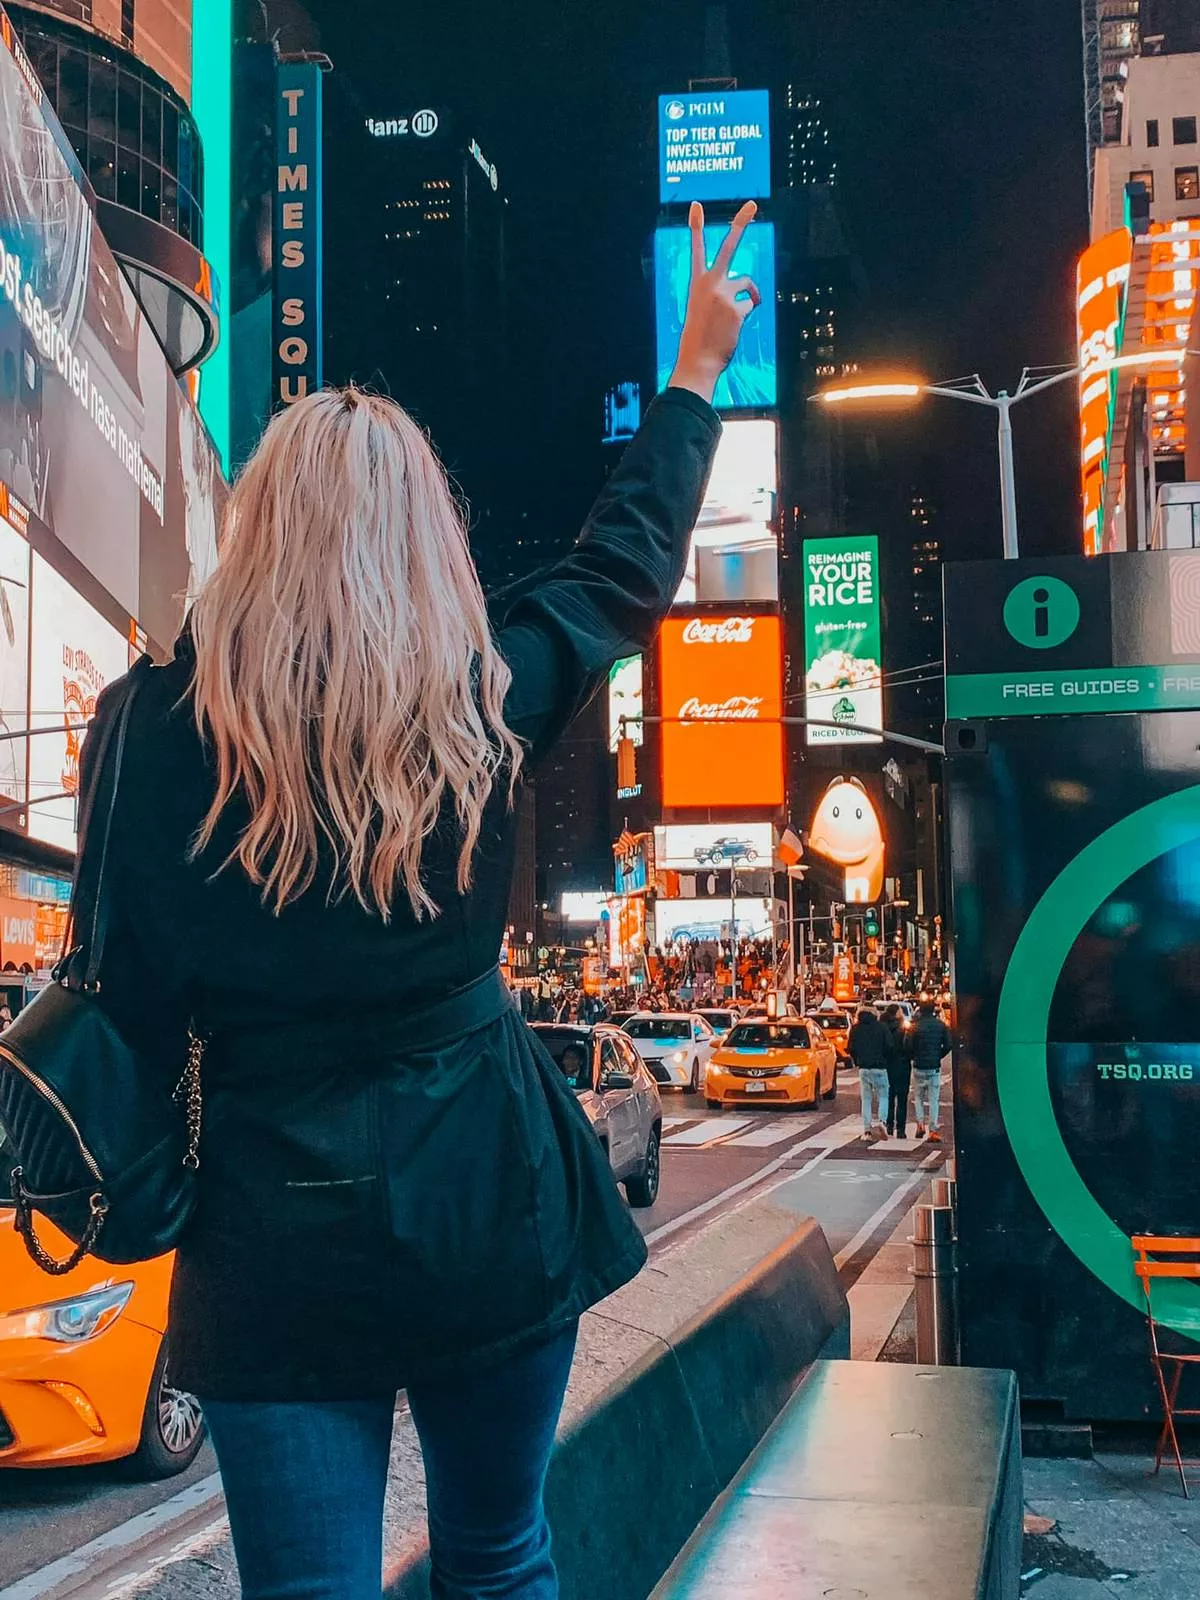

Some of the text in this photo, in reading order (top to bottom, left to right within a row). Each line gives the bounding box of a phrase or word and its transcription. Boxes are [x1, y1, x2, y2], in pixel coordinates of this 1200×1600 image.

[688, 101, 725, 117] PGIM
[666, 124, 763, 143] TOP TIER GLOBAL
[666, 141, 736, 159] INVESTMENT
[666, 156, 744, 174] MANAGEMENT
[277, 88, 308, 268] TIMES
[91, 383, 117, 451] nasa
[808, 550, 872, 565] REIMAGINE
[808, 562, 872, 584] YOUR
[808, 581, 873, 607] RICE
[682, 617, 756, 644] Coca-Cola
[814, 620, 868, 635] gluten-free
[1002, 682, 1054, 698] FREE
[1061, 679, 1140, 696] GUIDES
[678, 696, 763, 726] Coca-Cola
[812, 729, 838, 738] RICED
[1097, 1063, 1193, 1081] TSQ.ORG
